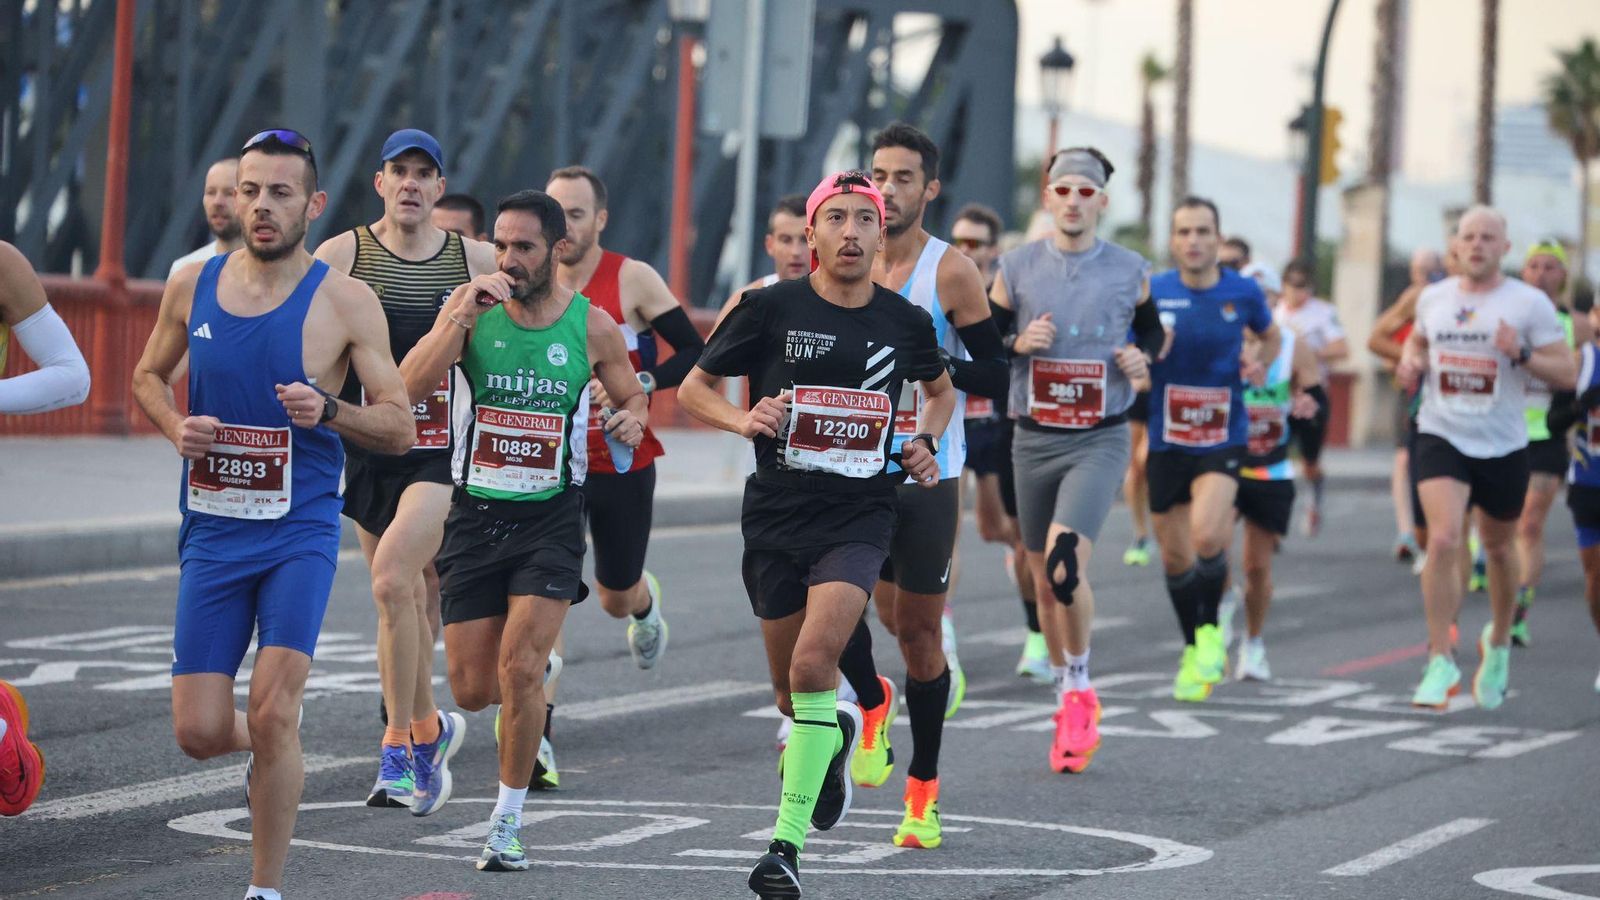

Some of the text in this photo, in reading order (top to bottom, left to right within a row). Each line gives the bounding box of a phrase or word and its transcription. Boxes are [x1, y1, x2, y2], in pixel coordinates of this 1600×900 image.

[815, 333, 836, 341] RUNNING
[785, 343, 814, 358] RUN
[486, 368, 568, 398] mijas
[822, 391, 885, 410] GENERALI
[498, 413, 557, 430] GENERALI
[814, 419, 869, 439] 12200
[214, 429, 282, 447] GENERALI
[491, 437, 542, 458] 10882
[207, 456, 267, 479] 12893
[219, 477, 252, 486] GIUSEPPE
[787, 797, 806, 805] CLUB
